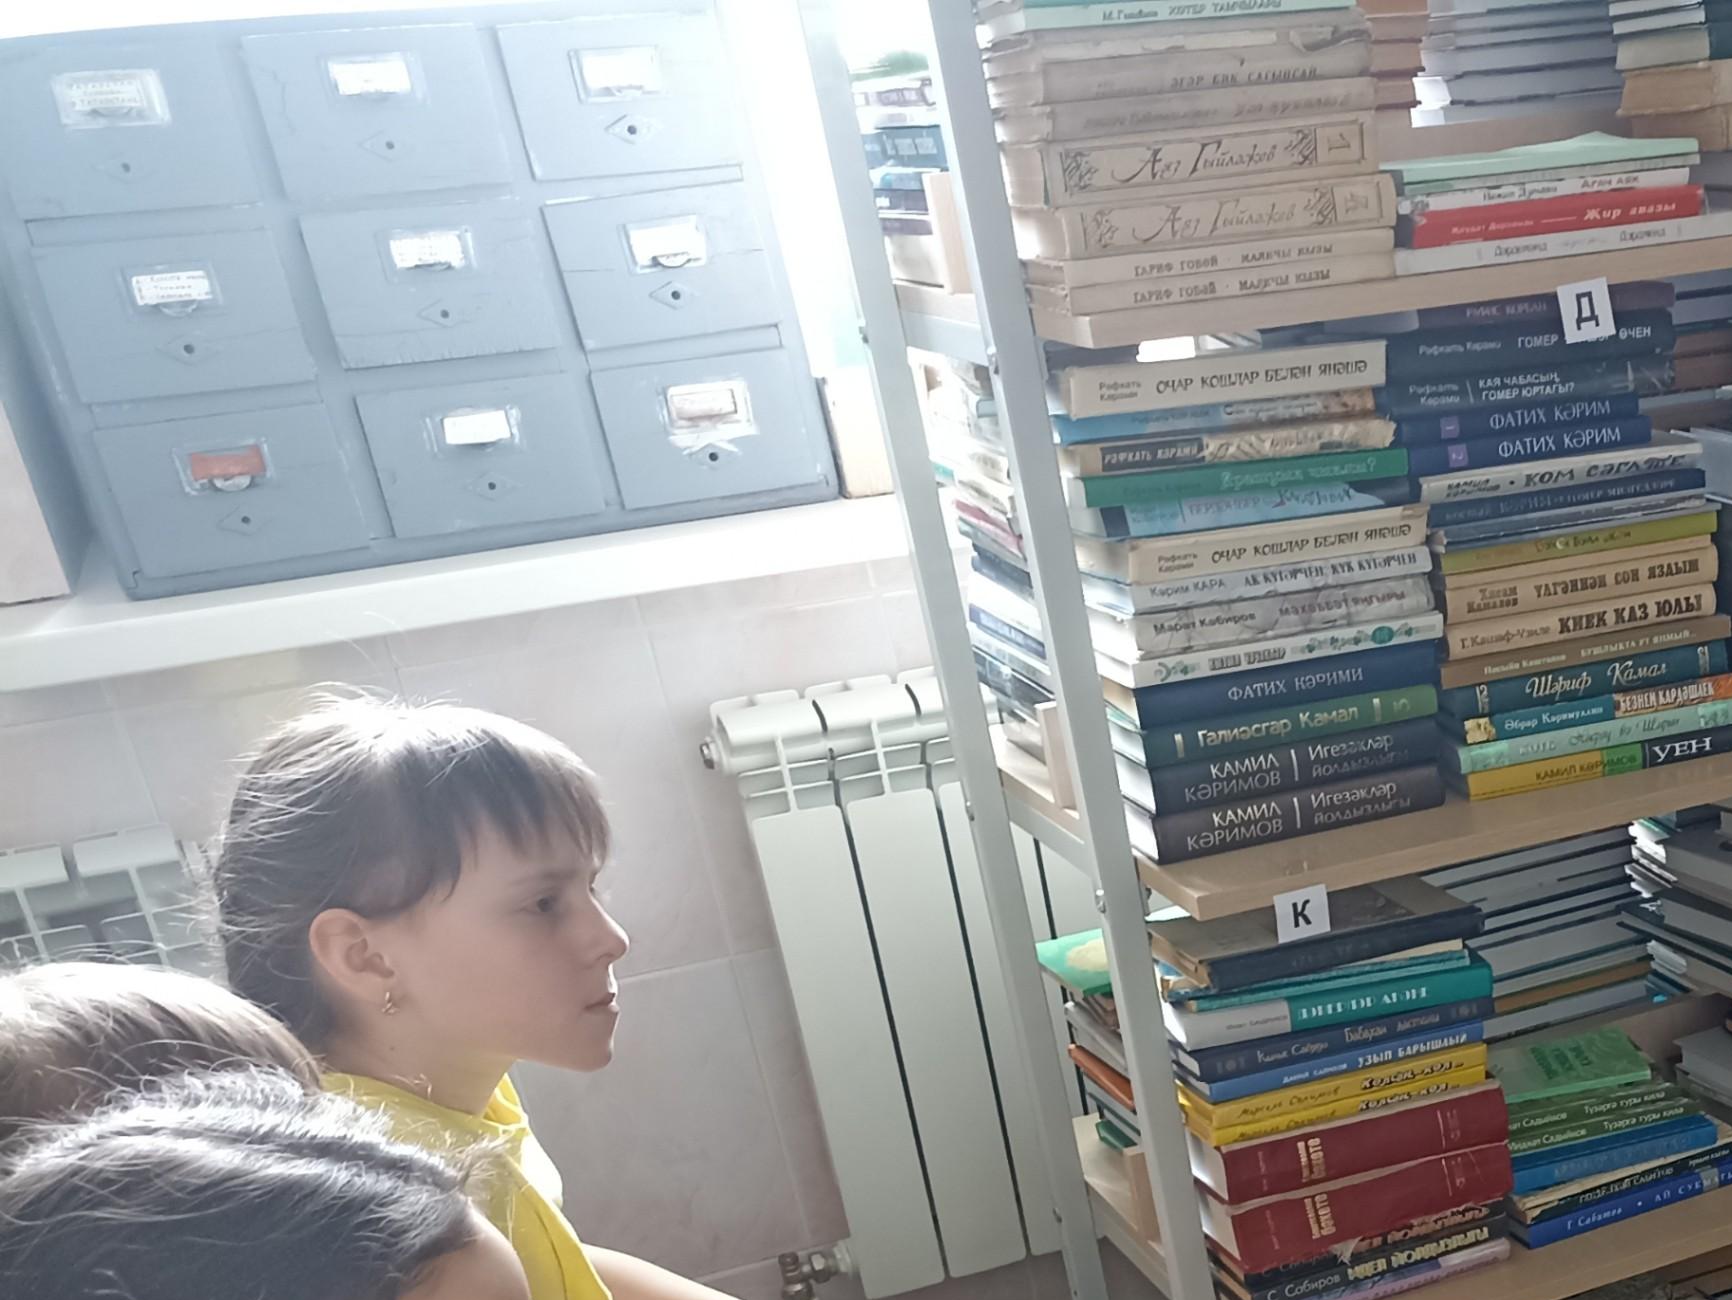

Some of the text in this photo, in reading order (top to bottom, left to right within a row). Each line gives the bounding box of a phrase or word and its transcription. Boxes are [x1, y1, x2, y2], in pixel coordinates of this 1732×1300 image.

[1575, 290, 1600, 330] Д
[1517, 326, 1652, 350] ГОМЕР ӨЧЕН
[1156, 360, 1368, 394] ОЧАР КОШЛАР БЕЛӘН ЯНӘШӘ
[1479, 376, 1501, 390] КАЯ
[1482, 387, 1519, 402] ГОМЕР
[1489, 400, 1612, 431] ФАТИХ КӘРИМ
[1498, 427, 1622, 459] ФАТИХ КӘРИМ
[1524, 469, 1576, 488] КОМ
[1211, 523, 1412, 564] ОЧАР КОШЛАР БЕЛӘН ЯНӘШӘ
[1558, 593, 1702, 634] КИЕК КАЗ ЮЛЫ
[1227, 667, 1364, 701] ФАТИХ КӘРИМИ
[1525, 661, 1668, 701] Шәриф Камал
[1197, 703, 1358, 748] Галиәсгар Камал
[1210, 752, 1280, 779] КАМИЛ
[1652, 737, 1713, 763] УЕН
[1184, 770, 1281, 803] КӘРИМОВ
[1212, 800, 1282, 828] КАМИЛ
[1187, 818, 1284, 851] КӘРИМОВ
[1292, 900, 1311, 928] К
[1357, 1032, 1468, 1068] УЗЫП БАРЫШЛЫЙ
[1347, 1256, 1388, 1281] ИДЕЛ
